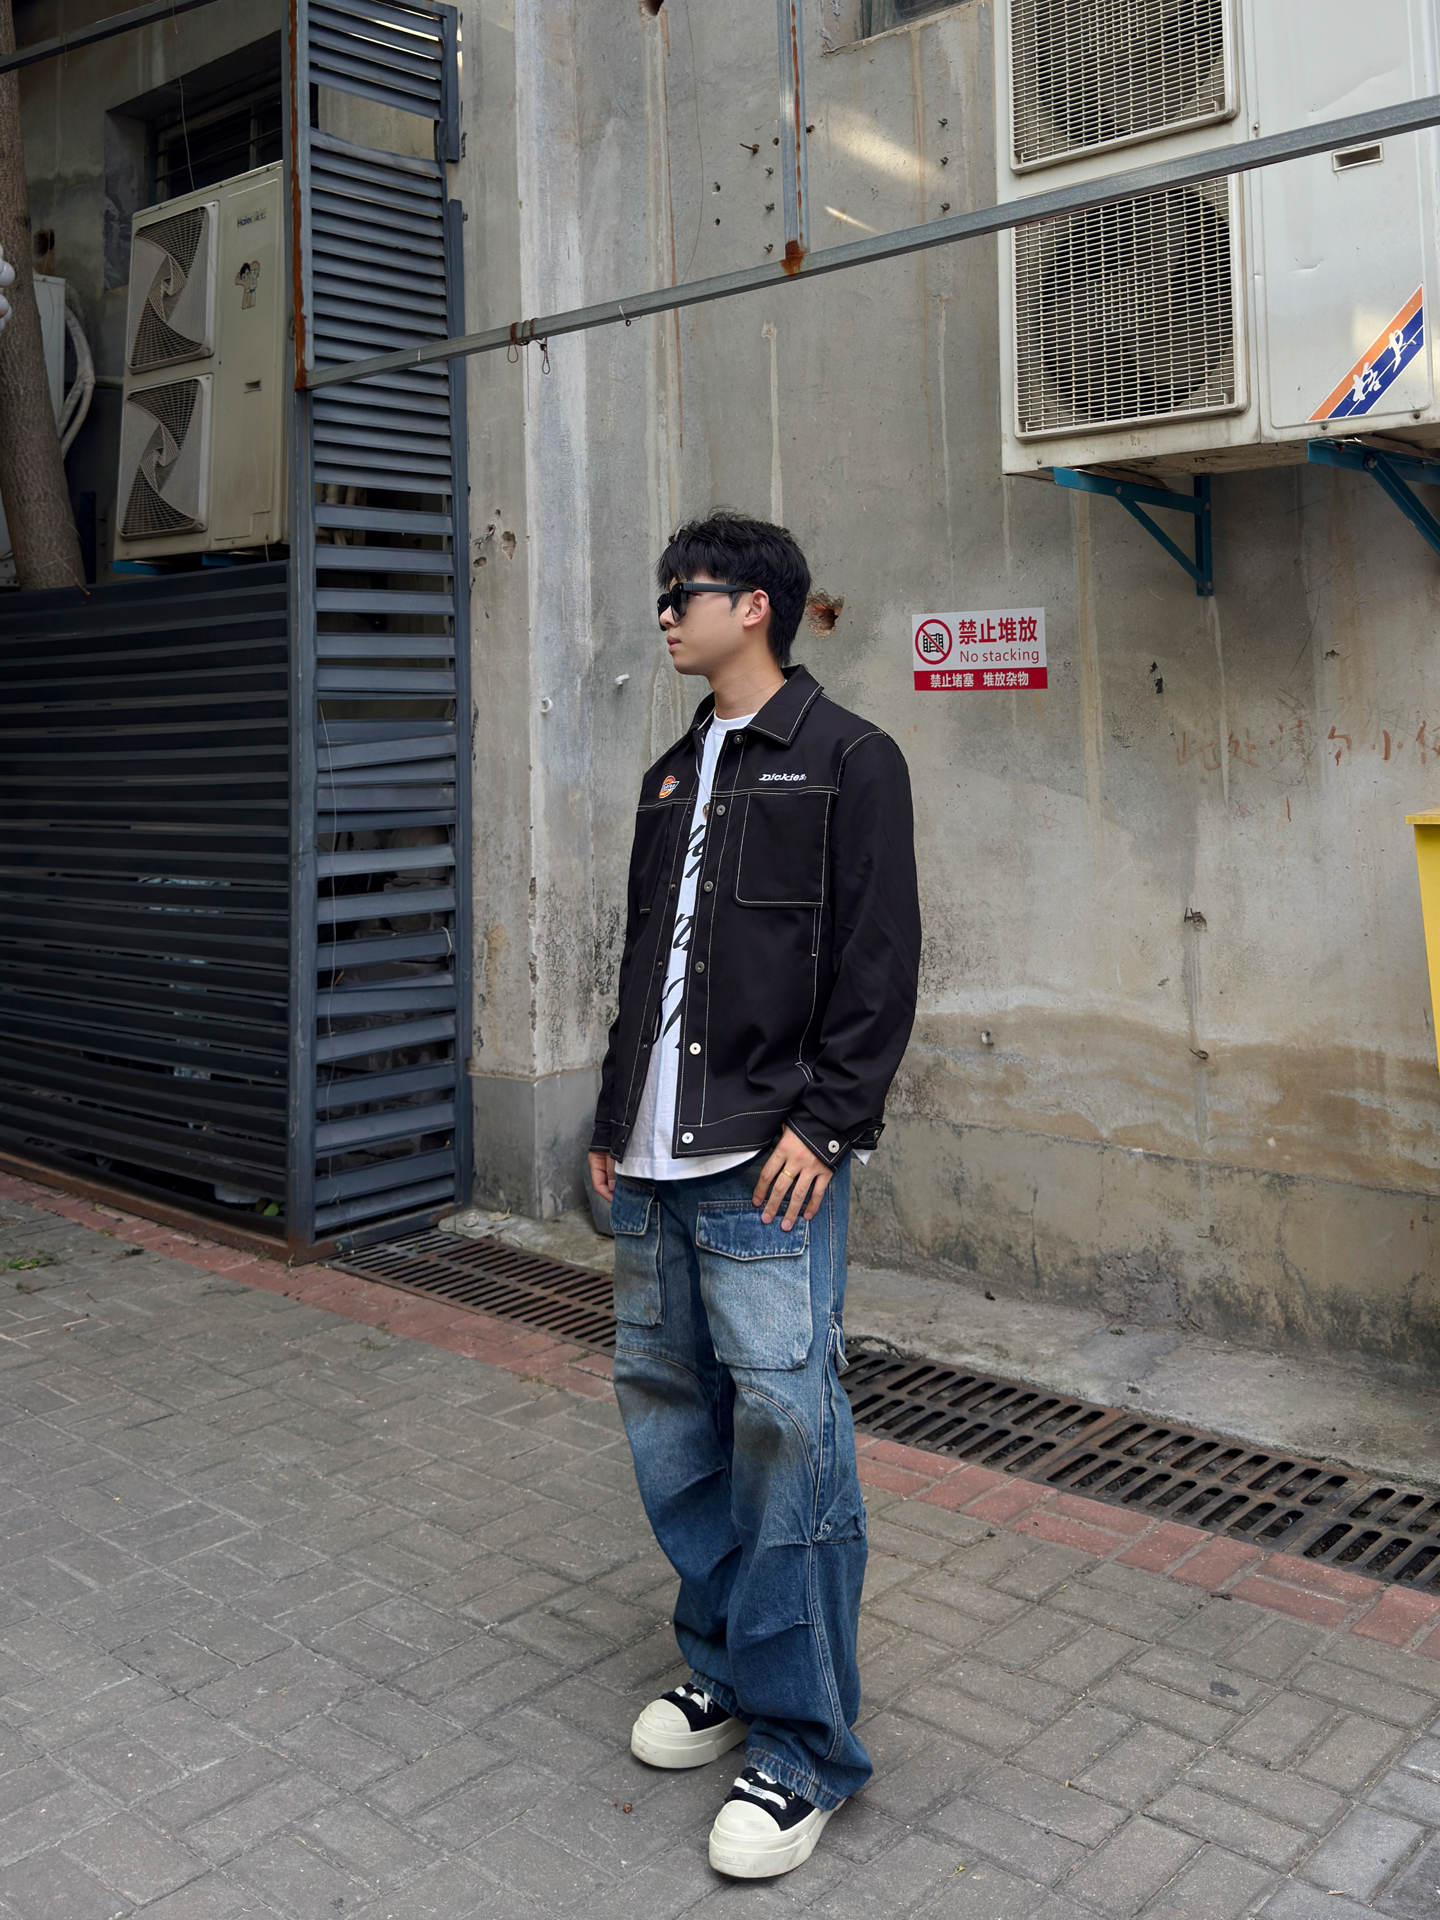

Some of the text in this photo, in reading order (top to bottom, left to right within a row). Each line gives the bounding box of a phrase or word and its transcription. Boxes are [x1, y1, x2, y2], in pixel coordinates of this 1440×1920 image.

[958, 616, 1038, 645] 禁止堆放
[960, 648, 1040, 664] No stacking
[930, 671, 1029, 688] 禁止堵塞 堆放杂物
[758, 773, 807, 781] Dickies
